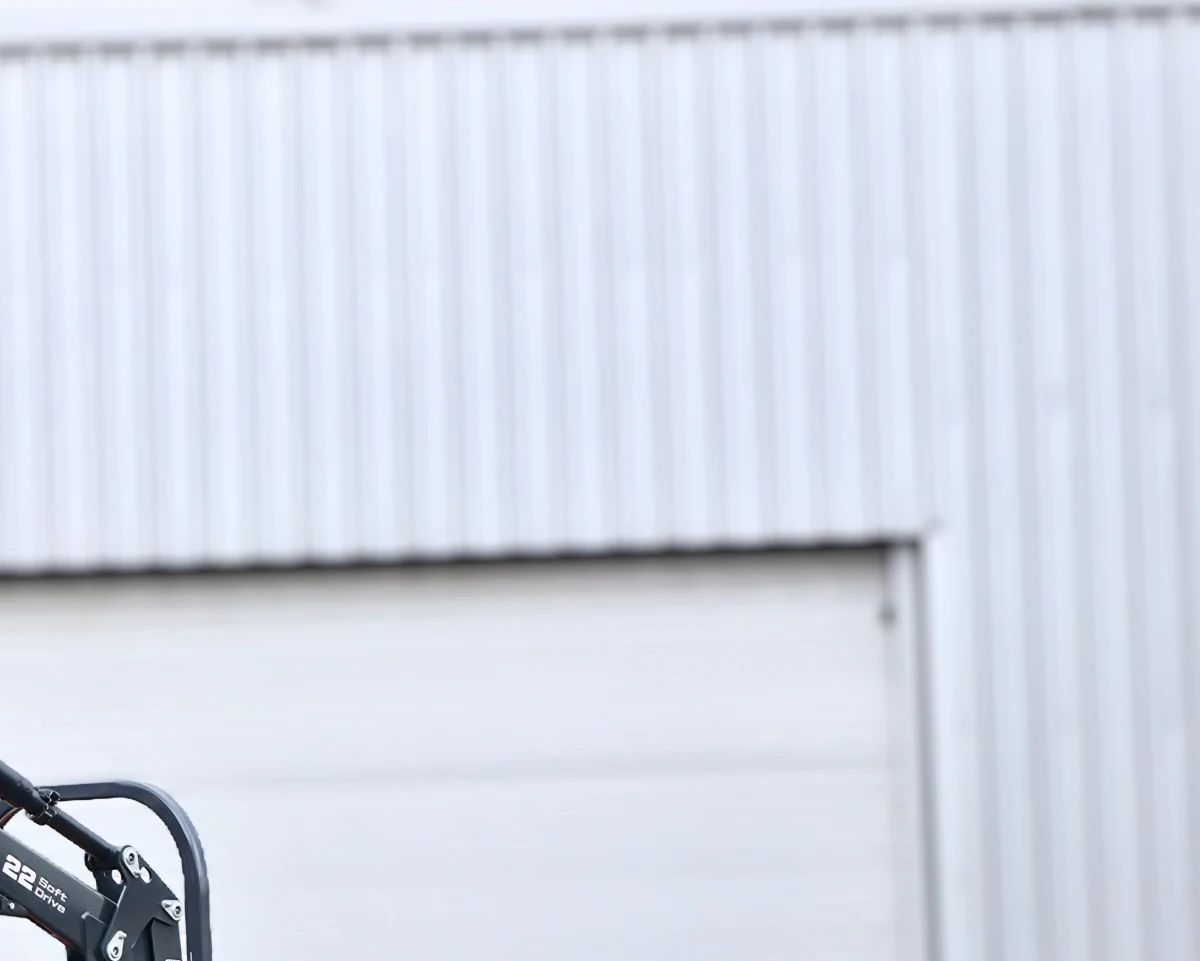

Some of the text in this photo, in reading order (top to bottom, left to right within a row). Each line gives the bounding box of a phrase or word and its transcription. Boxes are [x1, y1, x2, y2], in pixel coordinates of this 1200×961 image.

[2, 854, 37, 891] 22
[34, 889, 66, 914] Drive
[38, 876, 68, 902] Soft
